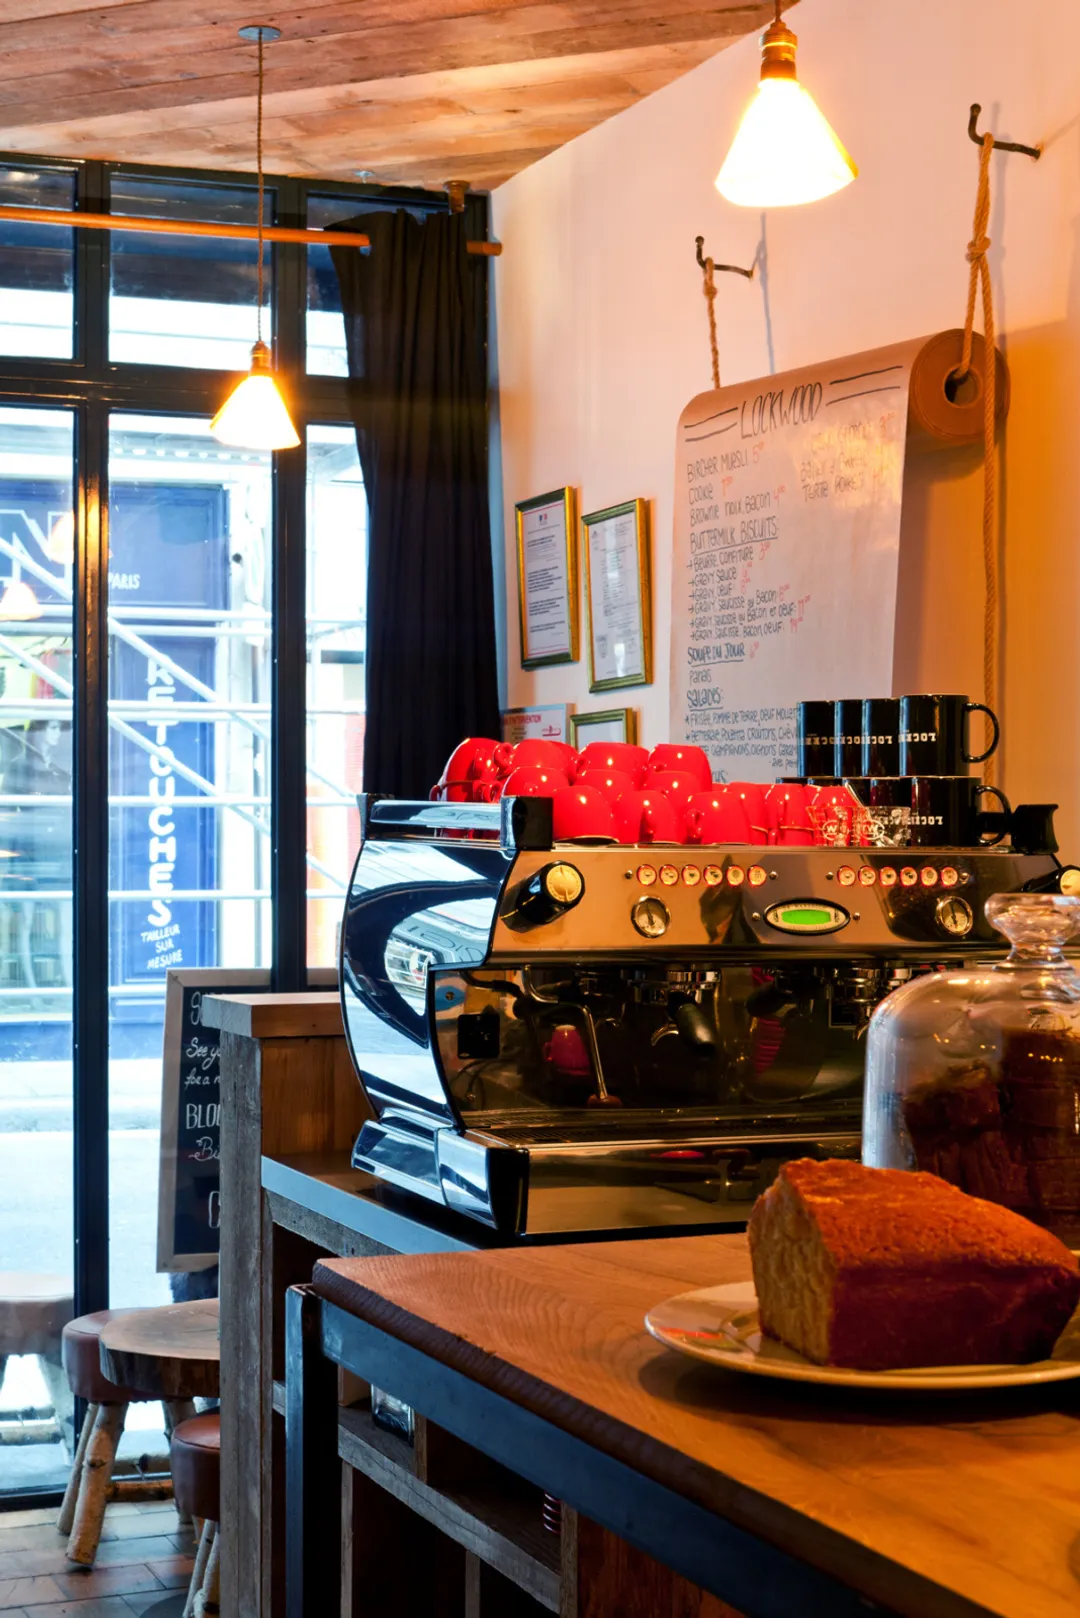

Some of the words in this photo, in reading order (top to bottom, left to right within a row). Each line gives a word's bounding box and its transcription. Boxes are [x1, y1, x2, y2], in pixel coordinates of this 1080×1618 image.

[741, 382, 823, 439] LOCKWOOD
[724, 642, 746, 660] JOUR
[141, 924, 180, 942] TAILLEUR
[156, 939, 174, 954] SUR
[147, 950, 183, 970] MESURE
[186, 1037, 208, 1058] See
